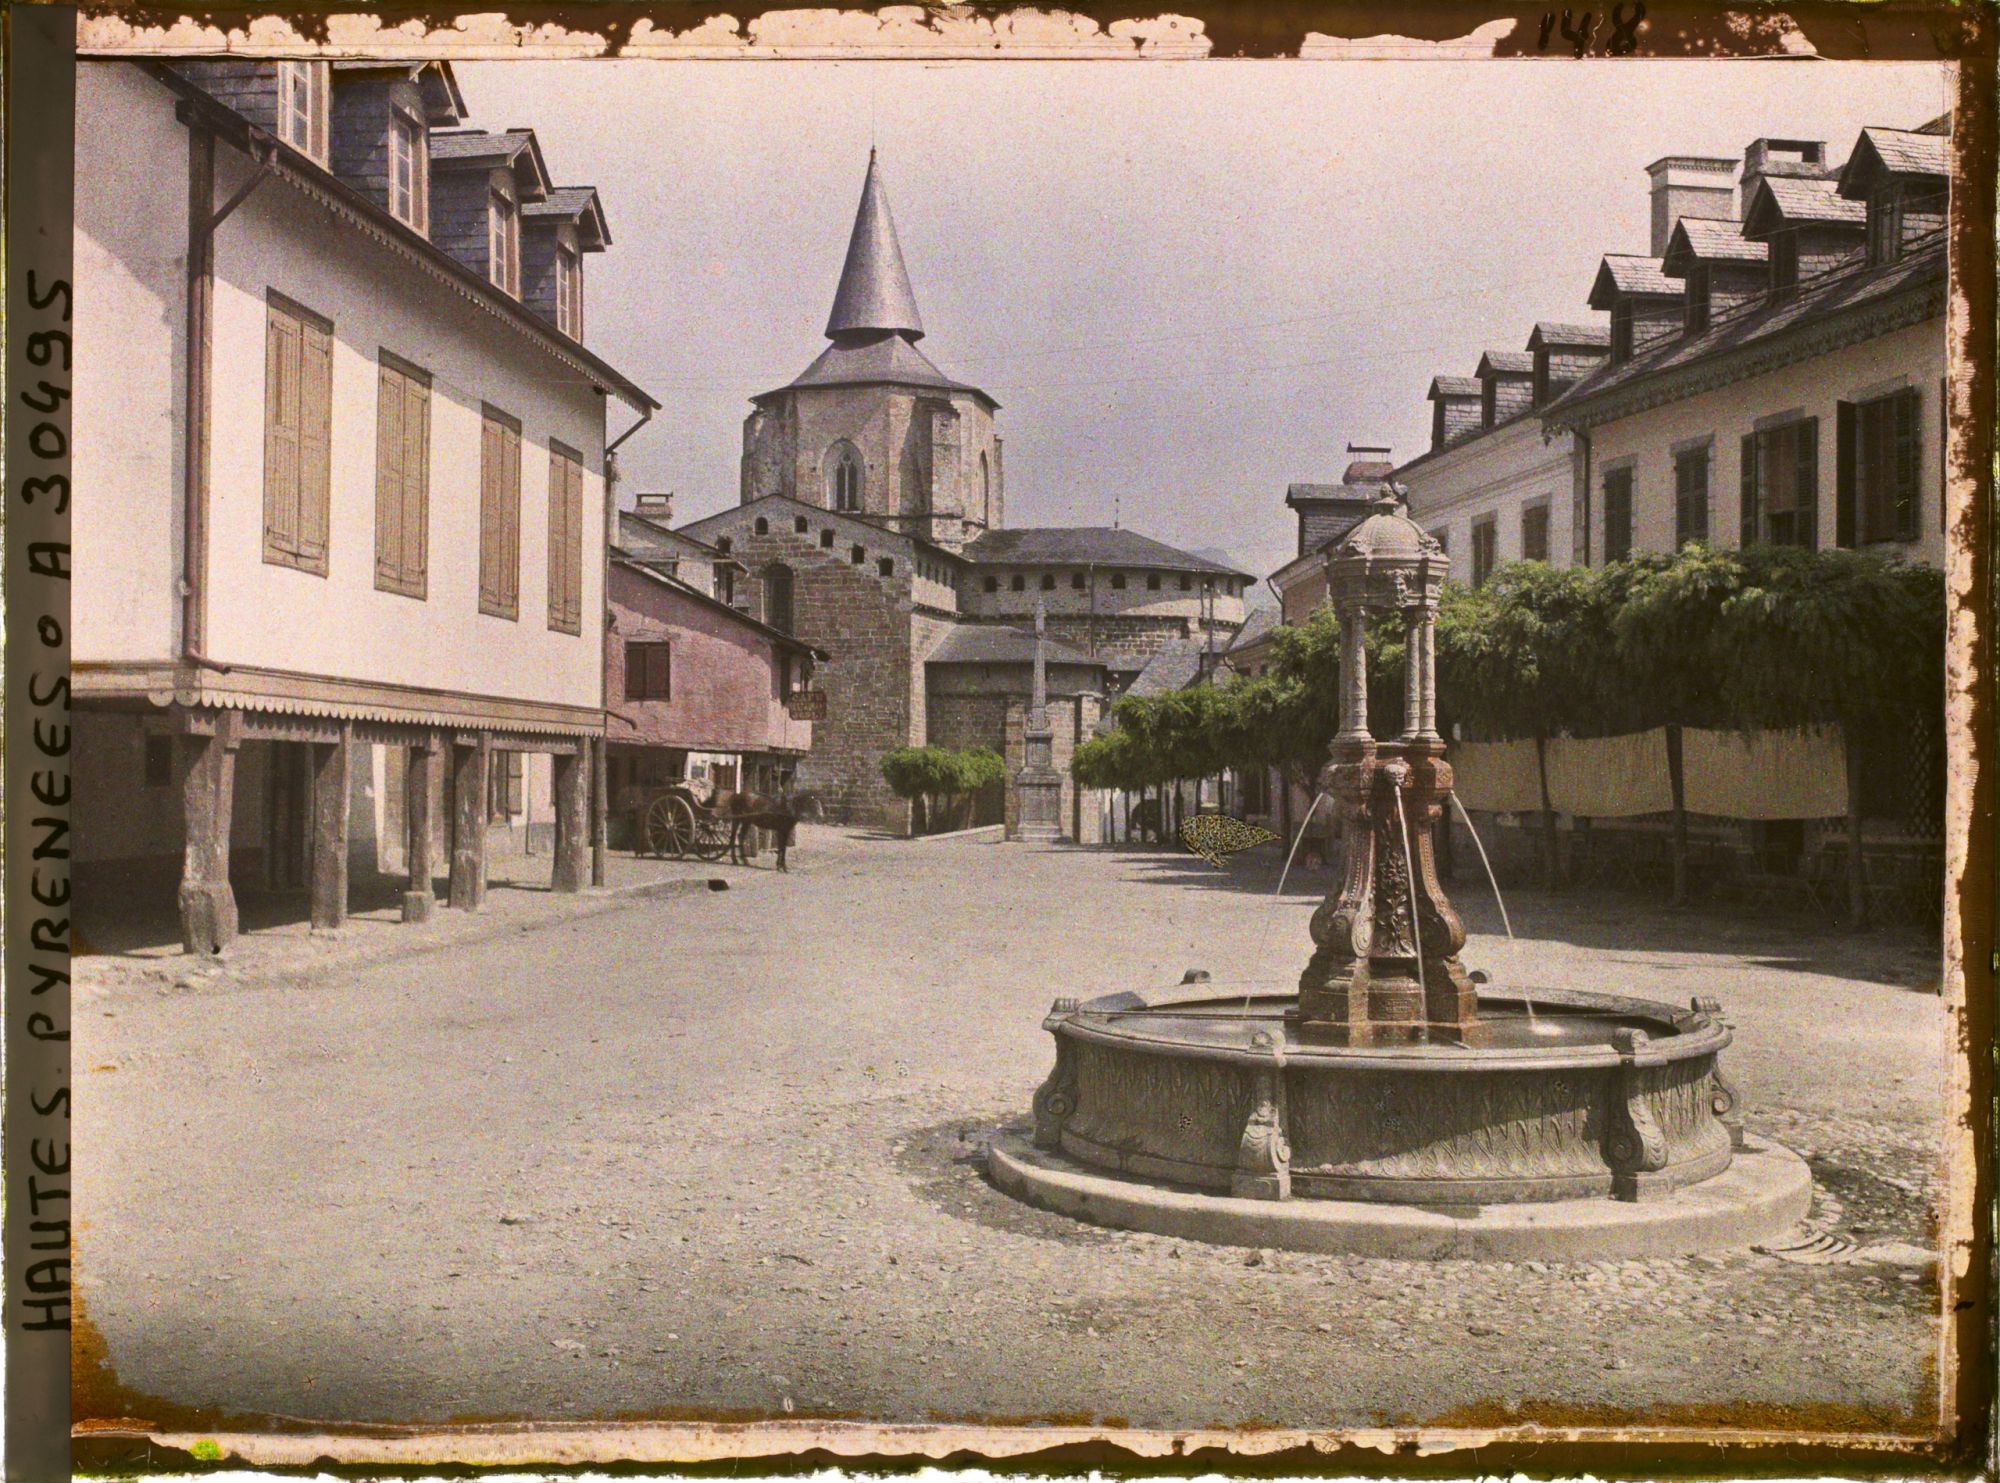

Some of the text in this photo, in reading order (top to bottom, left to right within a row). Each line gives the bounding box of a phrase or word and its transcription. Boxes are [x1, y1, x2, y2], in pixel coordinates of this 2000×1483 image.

[1538, 2, 1646, 60] 148
[21, 270, 72, 515] 30495
[27, 541, 71, 581] A
[27, 671, 71, 1042] PYRENEES
[22, 1088, 71, 1332] HAUTES
